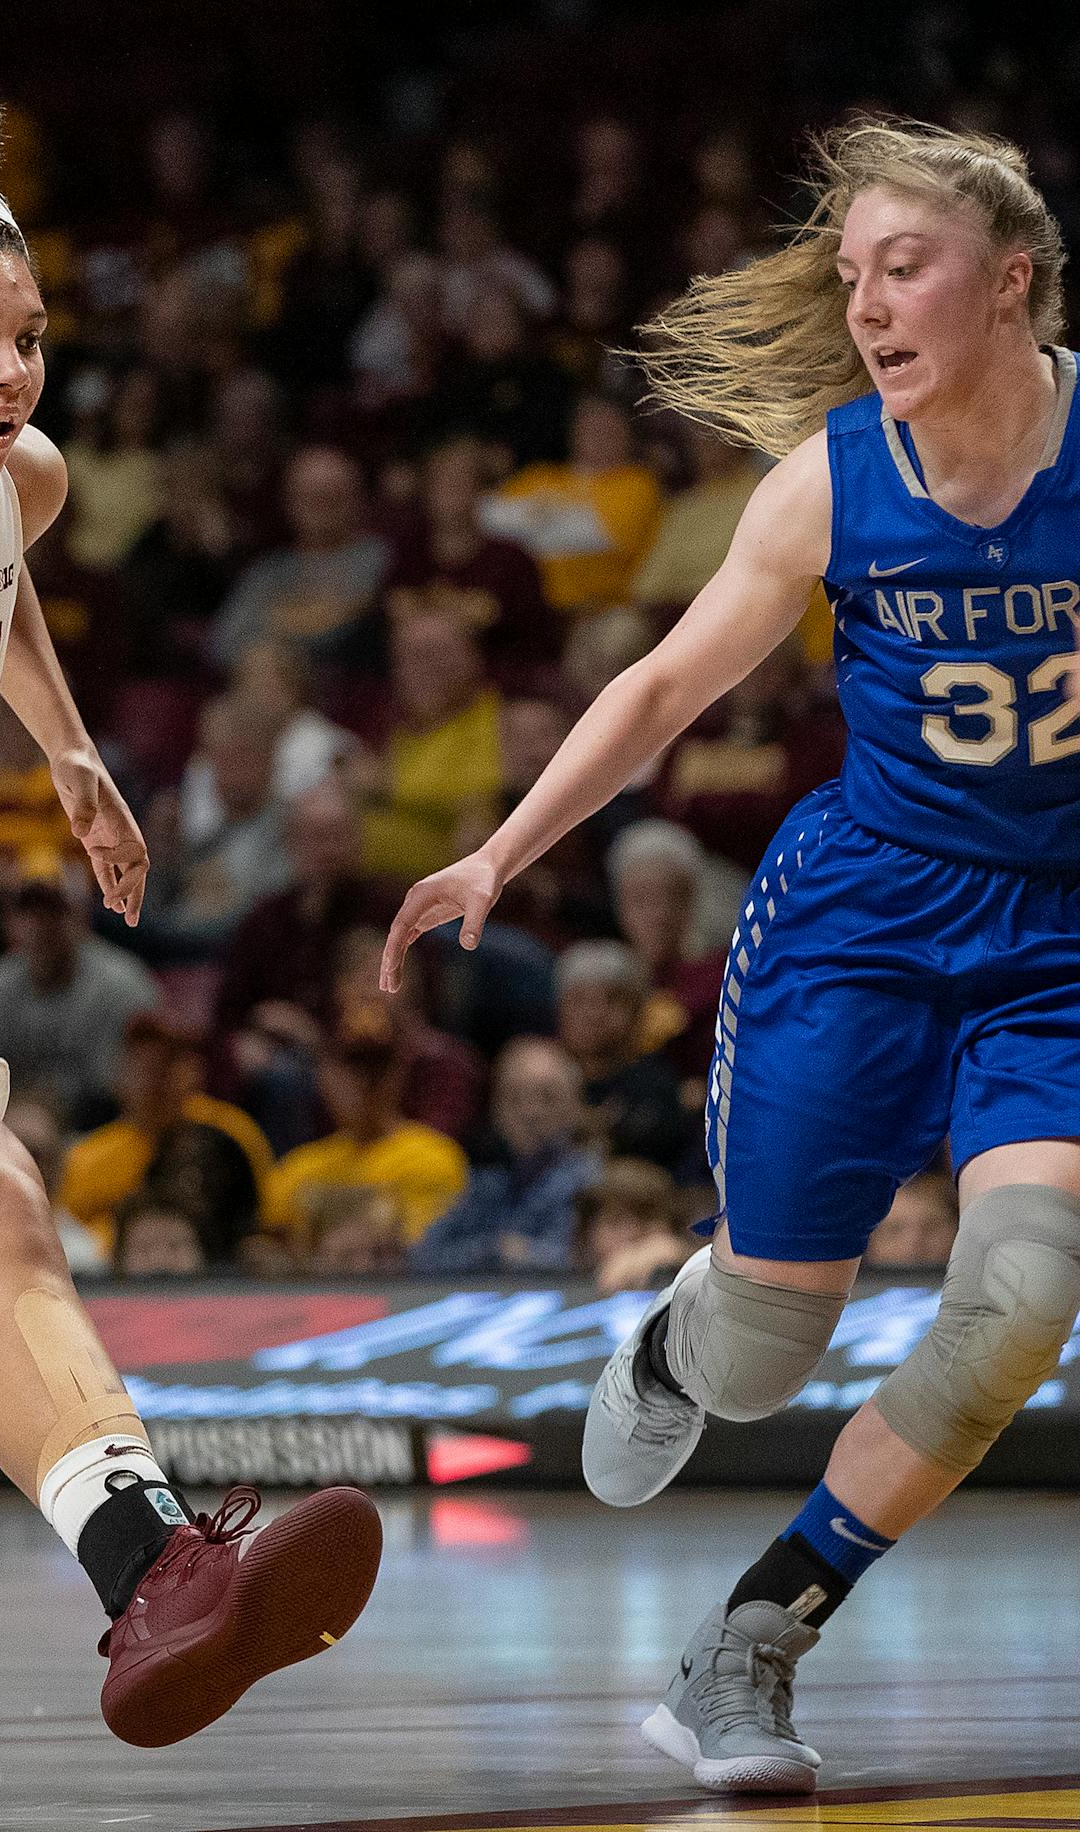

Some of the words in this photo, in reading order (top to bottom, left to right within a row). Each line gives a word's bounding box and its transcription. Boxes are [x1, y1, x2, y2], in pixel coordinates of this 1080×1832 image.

[986, 544, 1003, 562] AF
[874, 589, 948, 642] AIR
[920, 650, 1080, 767] 32
[149, 1416, 415, 1485] POSSESSION
